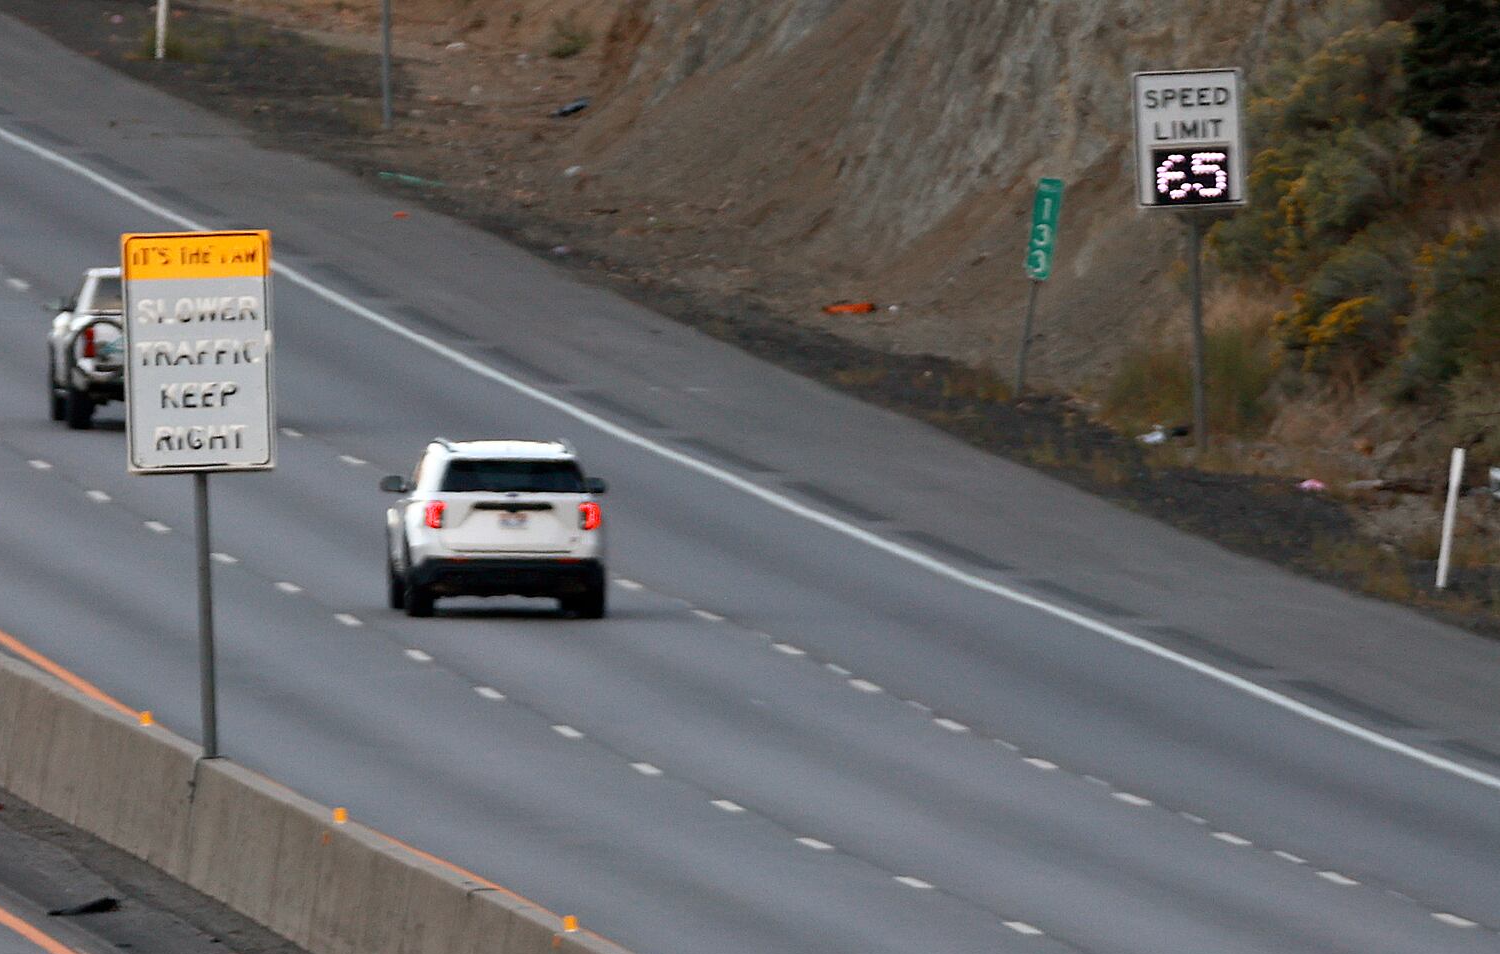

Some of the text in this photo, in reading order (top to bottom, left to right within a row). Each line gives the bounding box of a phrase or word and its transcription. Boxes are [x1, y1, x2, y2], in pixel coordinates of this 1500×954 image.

[1144, 87, 1229, 108] SPEED
[1154, 119, 1223, 141] LIMIT
[1156, 152, 1227, 199] 65
[180, 245, 214, 265] THE
[137, 296, 260, 324] SLOWER
[136, 338, 261, 366] TRAFFIC
[160, 380, 238, 409] KEEP
[155, 424, 248, 451] RIGHT
